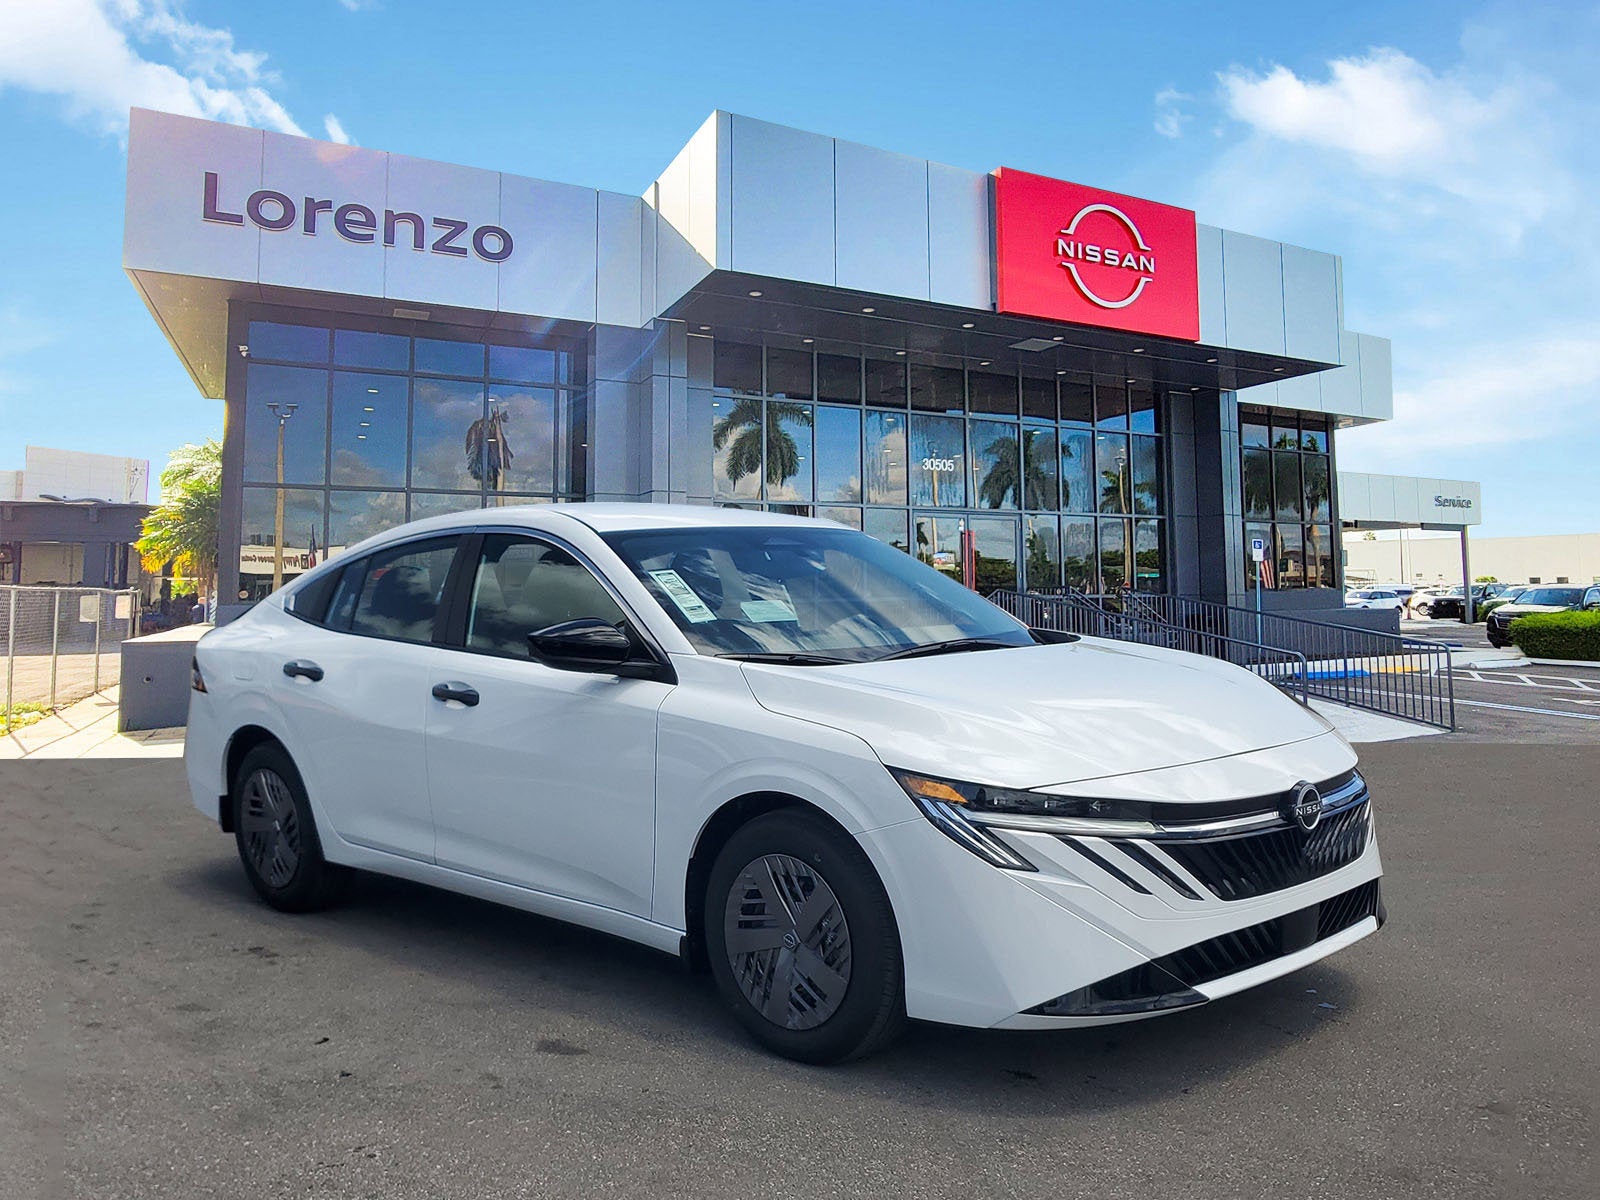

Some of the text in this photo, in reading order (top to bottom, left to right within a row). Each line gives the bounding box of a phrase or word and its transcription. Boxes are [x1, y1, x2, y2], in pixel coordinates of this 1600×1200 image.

[202, 171, 514, 262] Lorenzo
[1057, 238, 1155, 273] NISSAN
[922, 458, 954, 471] 30505
[1434, 495, 1472, 508] Service
[1295, 804, 1321, 816] NISSA
